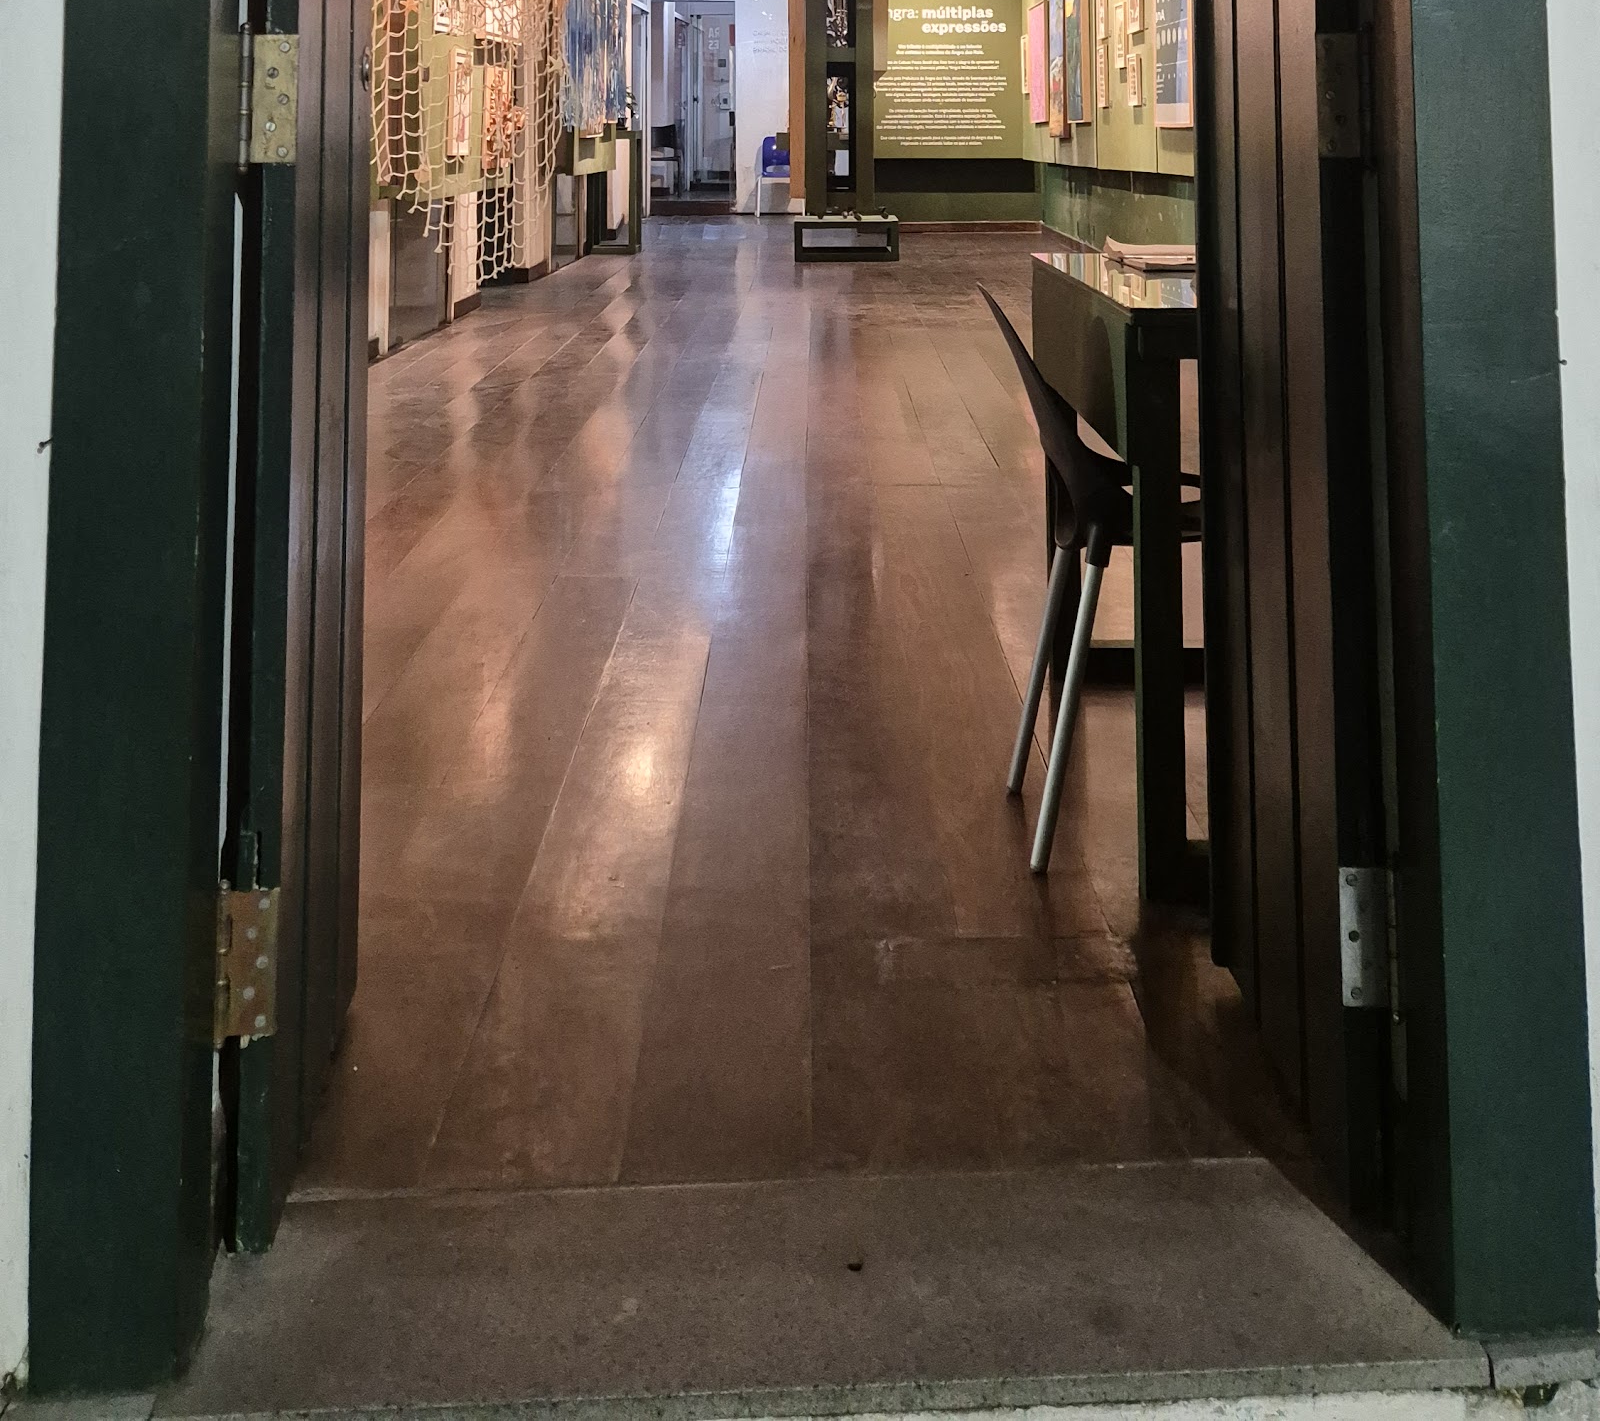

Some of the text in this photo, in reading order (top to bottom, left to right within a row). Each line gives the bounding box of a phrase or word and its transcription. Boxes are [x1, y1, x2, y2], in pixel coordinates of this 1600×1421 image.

[888, 6, 993, 21] ngra: múltiplas
[921, 21, 1006, 35] expressões
